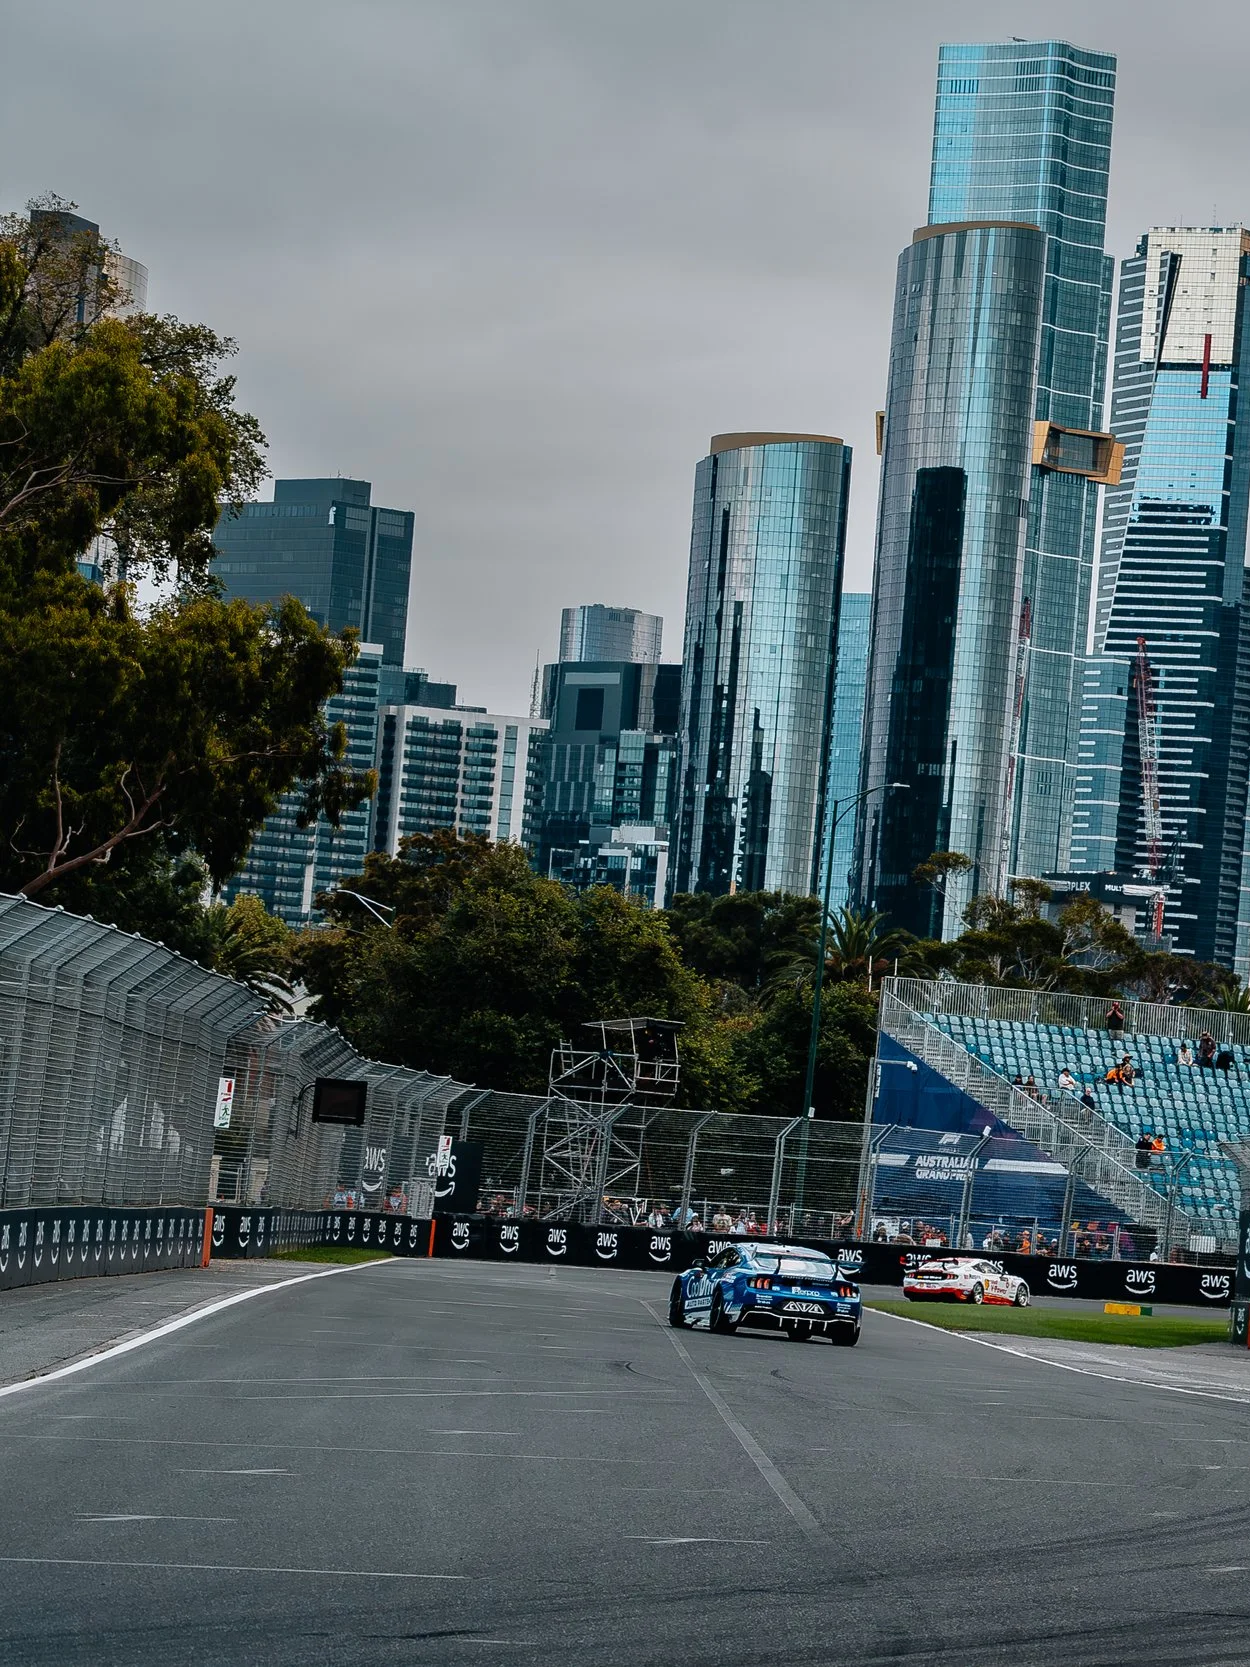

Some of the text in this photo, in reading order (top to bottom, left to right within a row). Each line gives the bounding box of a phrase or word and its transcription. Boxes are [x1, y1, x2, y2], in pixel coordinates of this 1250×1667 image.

[1068, 881, 1090, 891] PLEX
[1105, 884, 1122, 892] MULT
[212, 1213, 225, 1232] aws
[240, 1217, 251, 1232] aws
[453, 1222, 469, 1237] aws
[501, 1226, 519, 1240] aws
[548, 1229, 566, 1243] aws
[596, 1233, 617, 1250] aws
[651, 1236, 670, 1250] aws
[838, 1249, 862, 1262] aws
[1047, 1265, 1076, 1280] aws
[1127, 1270, 1155, 1283] aws
[1200, 1275, 1229, 1290] aws
